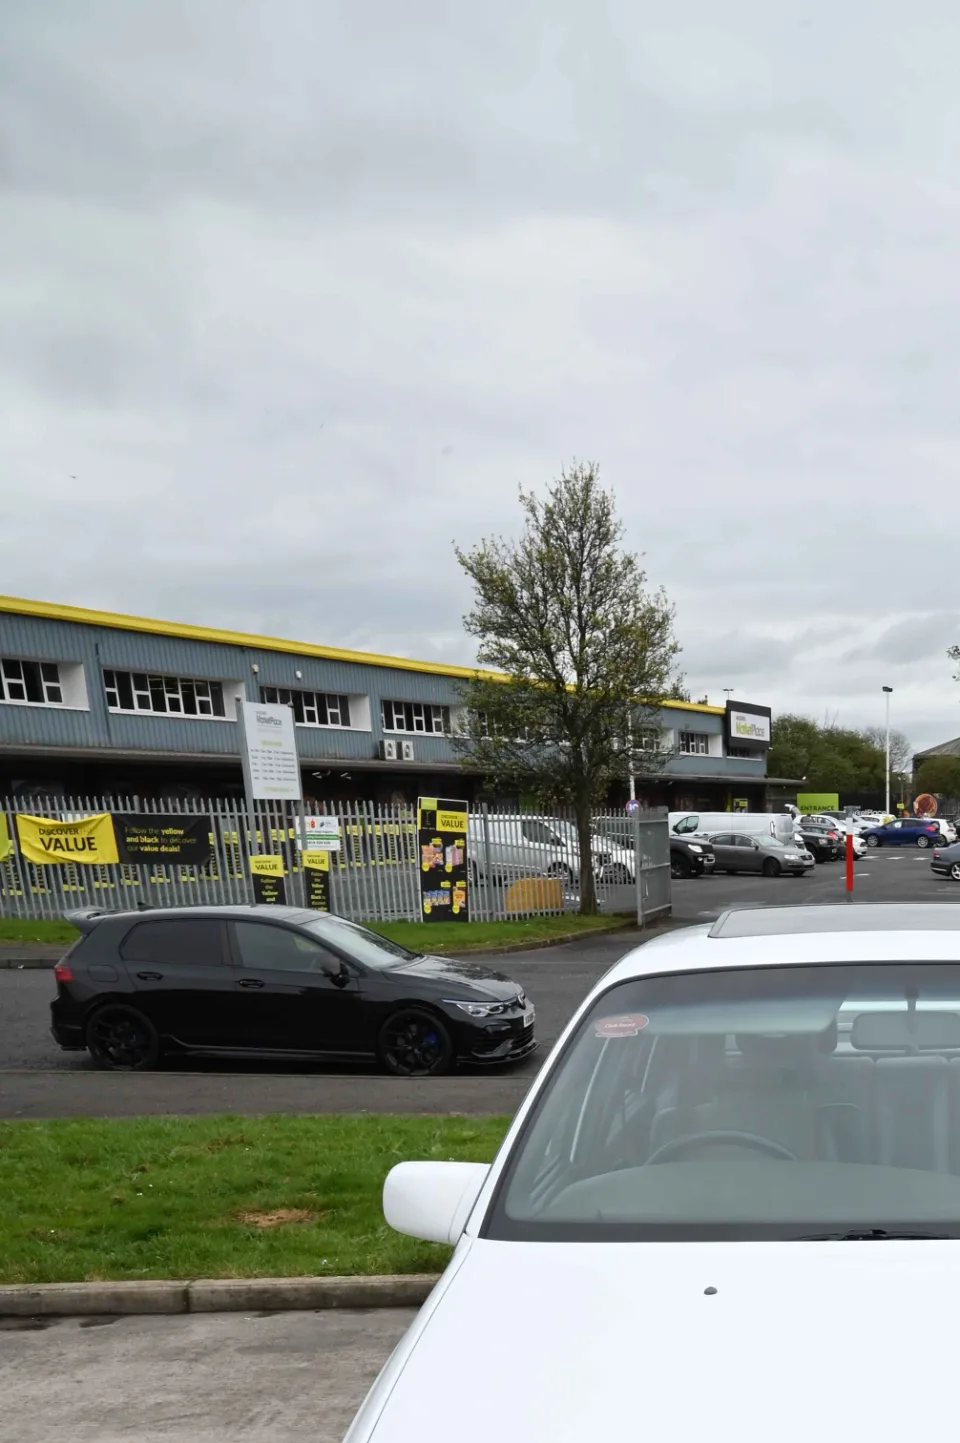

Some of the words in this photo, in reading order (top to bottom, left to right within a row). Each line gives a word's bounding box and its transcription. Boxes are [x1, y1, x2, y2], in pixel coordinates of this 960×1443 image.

[441, 819, 464, 828] VALUE
[39, 827, 78, 835] DISCOVER
[125, 826, 147, 834] Follow
[161, 828, 184, 836] yellow
[40, 836, 97, 851] VALUE
[126, 835, 139, 843] and
[140, 835, 159, 843] black
[169, 836, 197, 844] discover
[140, 844, 159, 852] value
